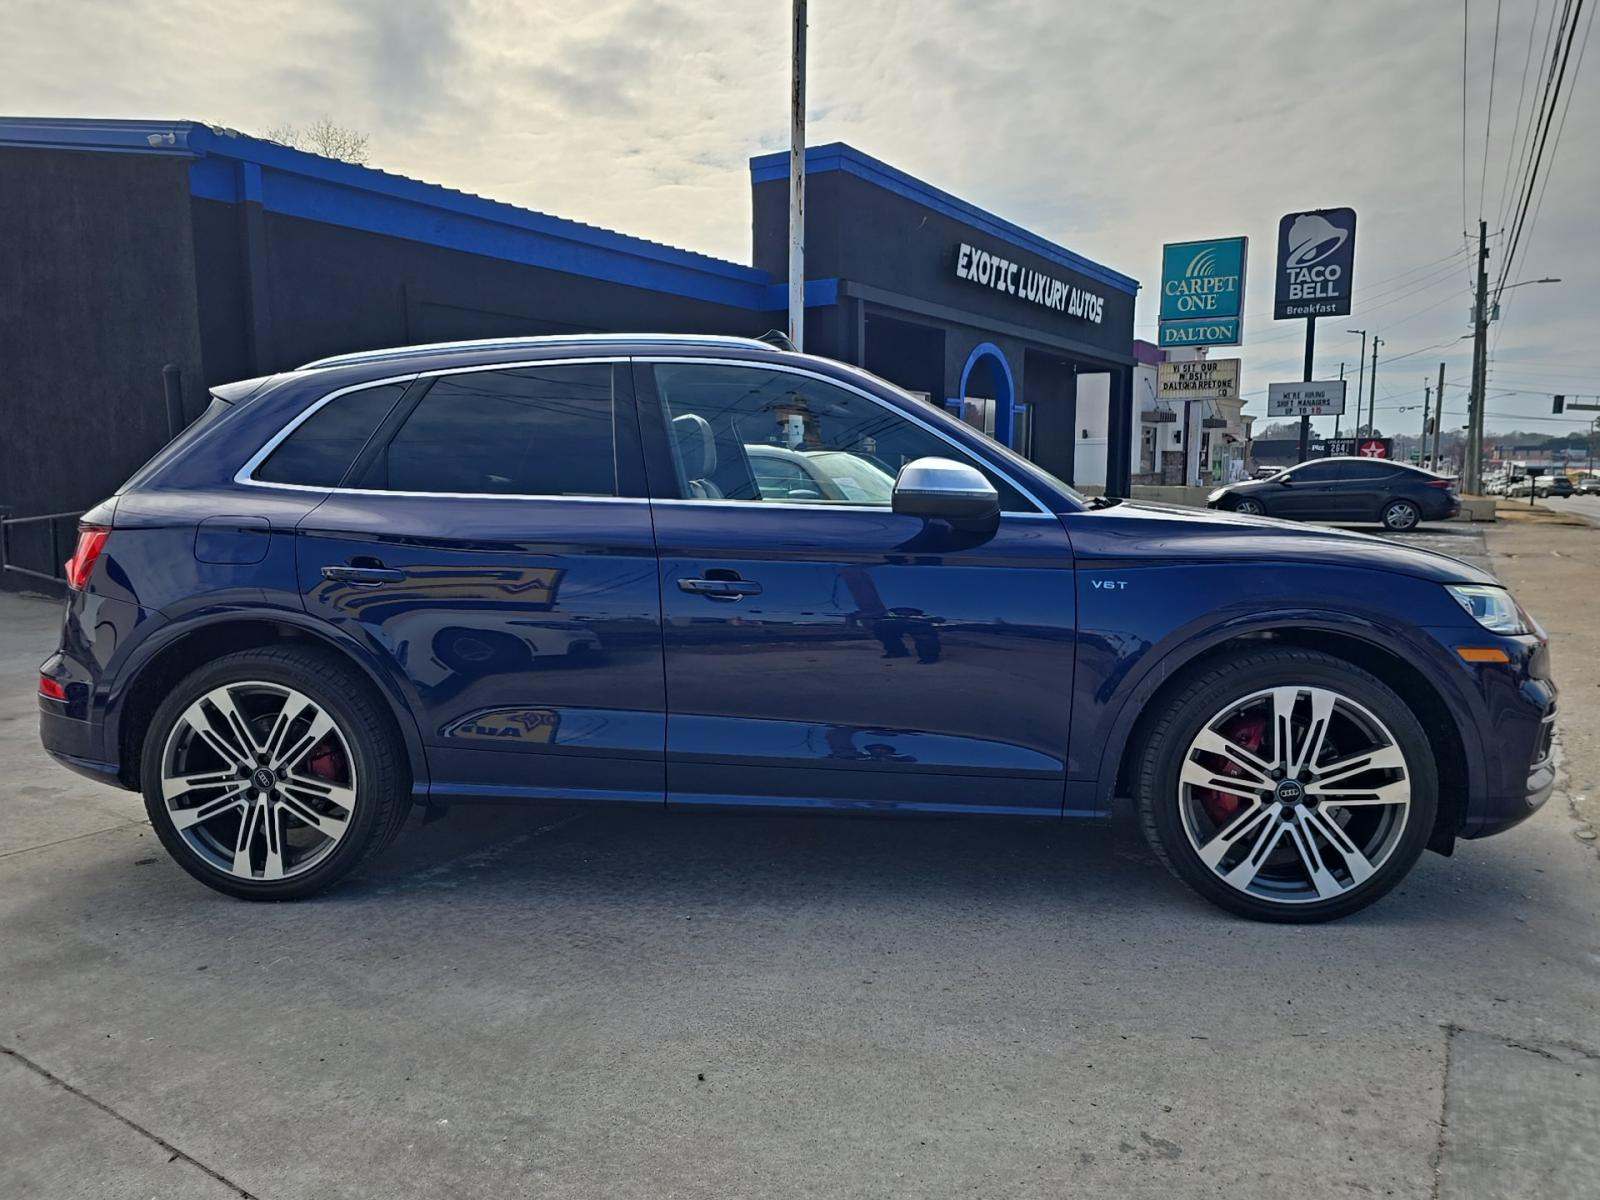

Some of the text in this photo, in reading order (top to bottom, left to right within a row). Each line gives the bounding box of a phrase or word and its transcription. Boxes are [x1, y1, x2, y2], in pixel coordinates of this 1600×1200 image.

[1286, 264, 1341, 284] TACO
[956, 243, 1104, 324] EXOTIC LUXURY AUTOS
[1165, 276, 1238, 296] CARPET
[1289, 281, 1339, 300] BELL
[1177, 294, 1217, 311] ONE
[1287, 303, 1337, 315] Breakfast
[1165, 326, 1232, 341] DALTON
[1200, 363, 1217, 372] OUR
